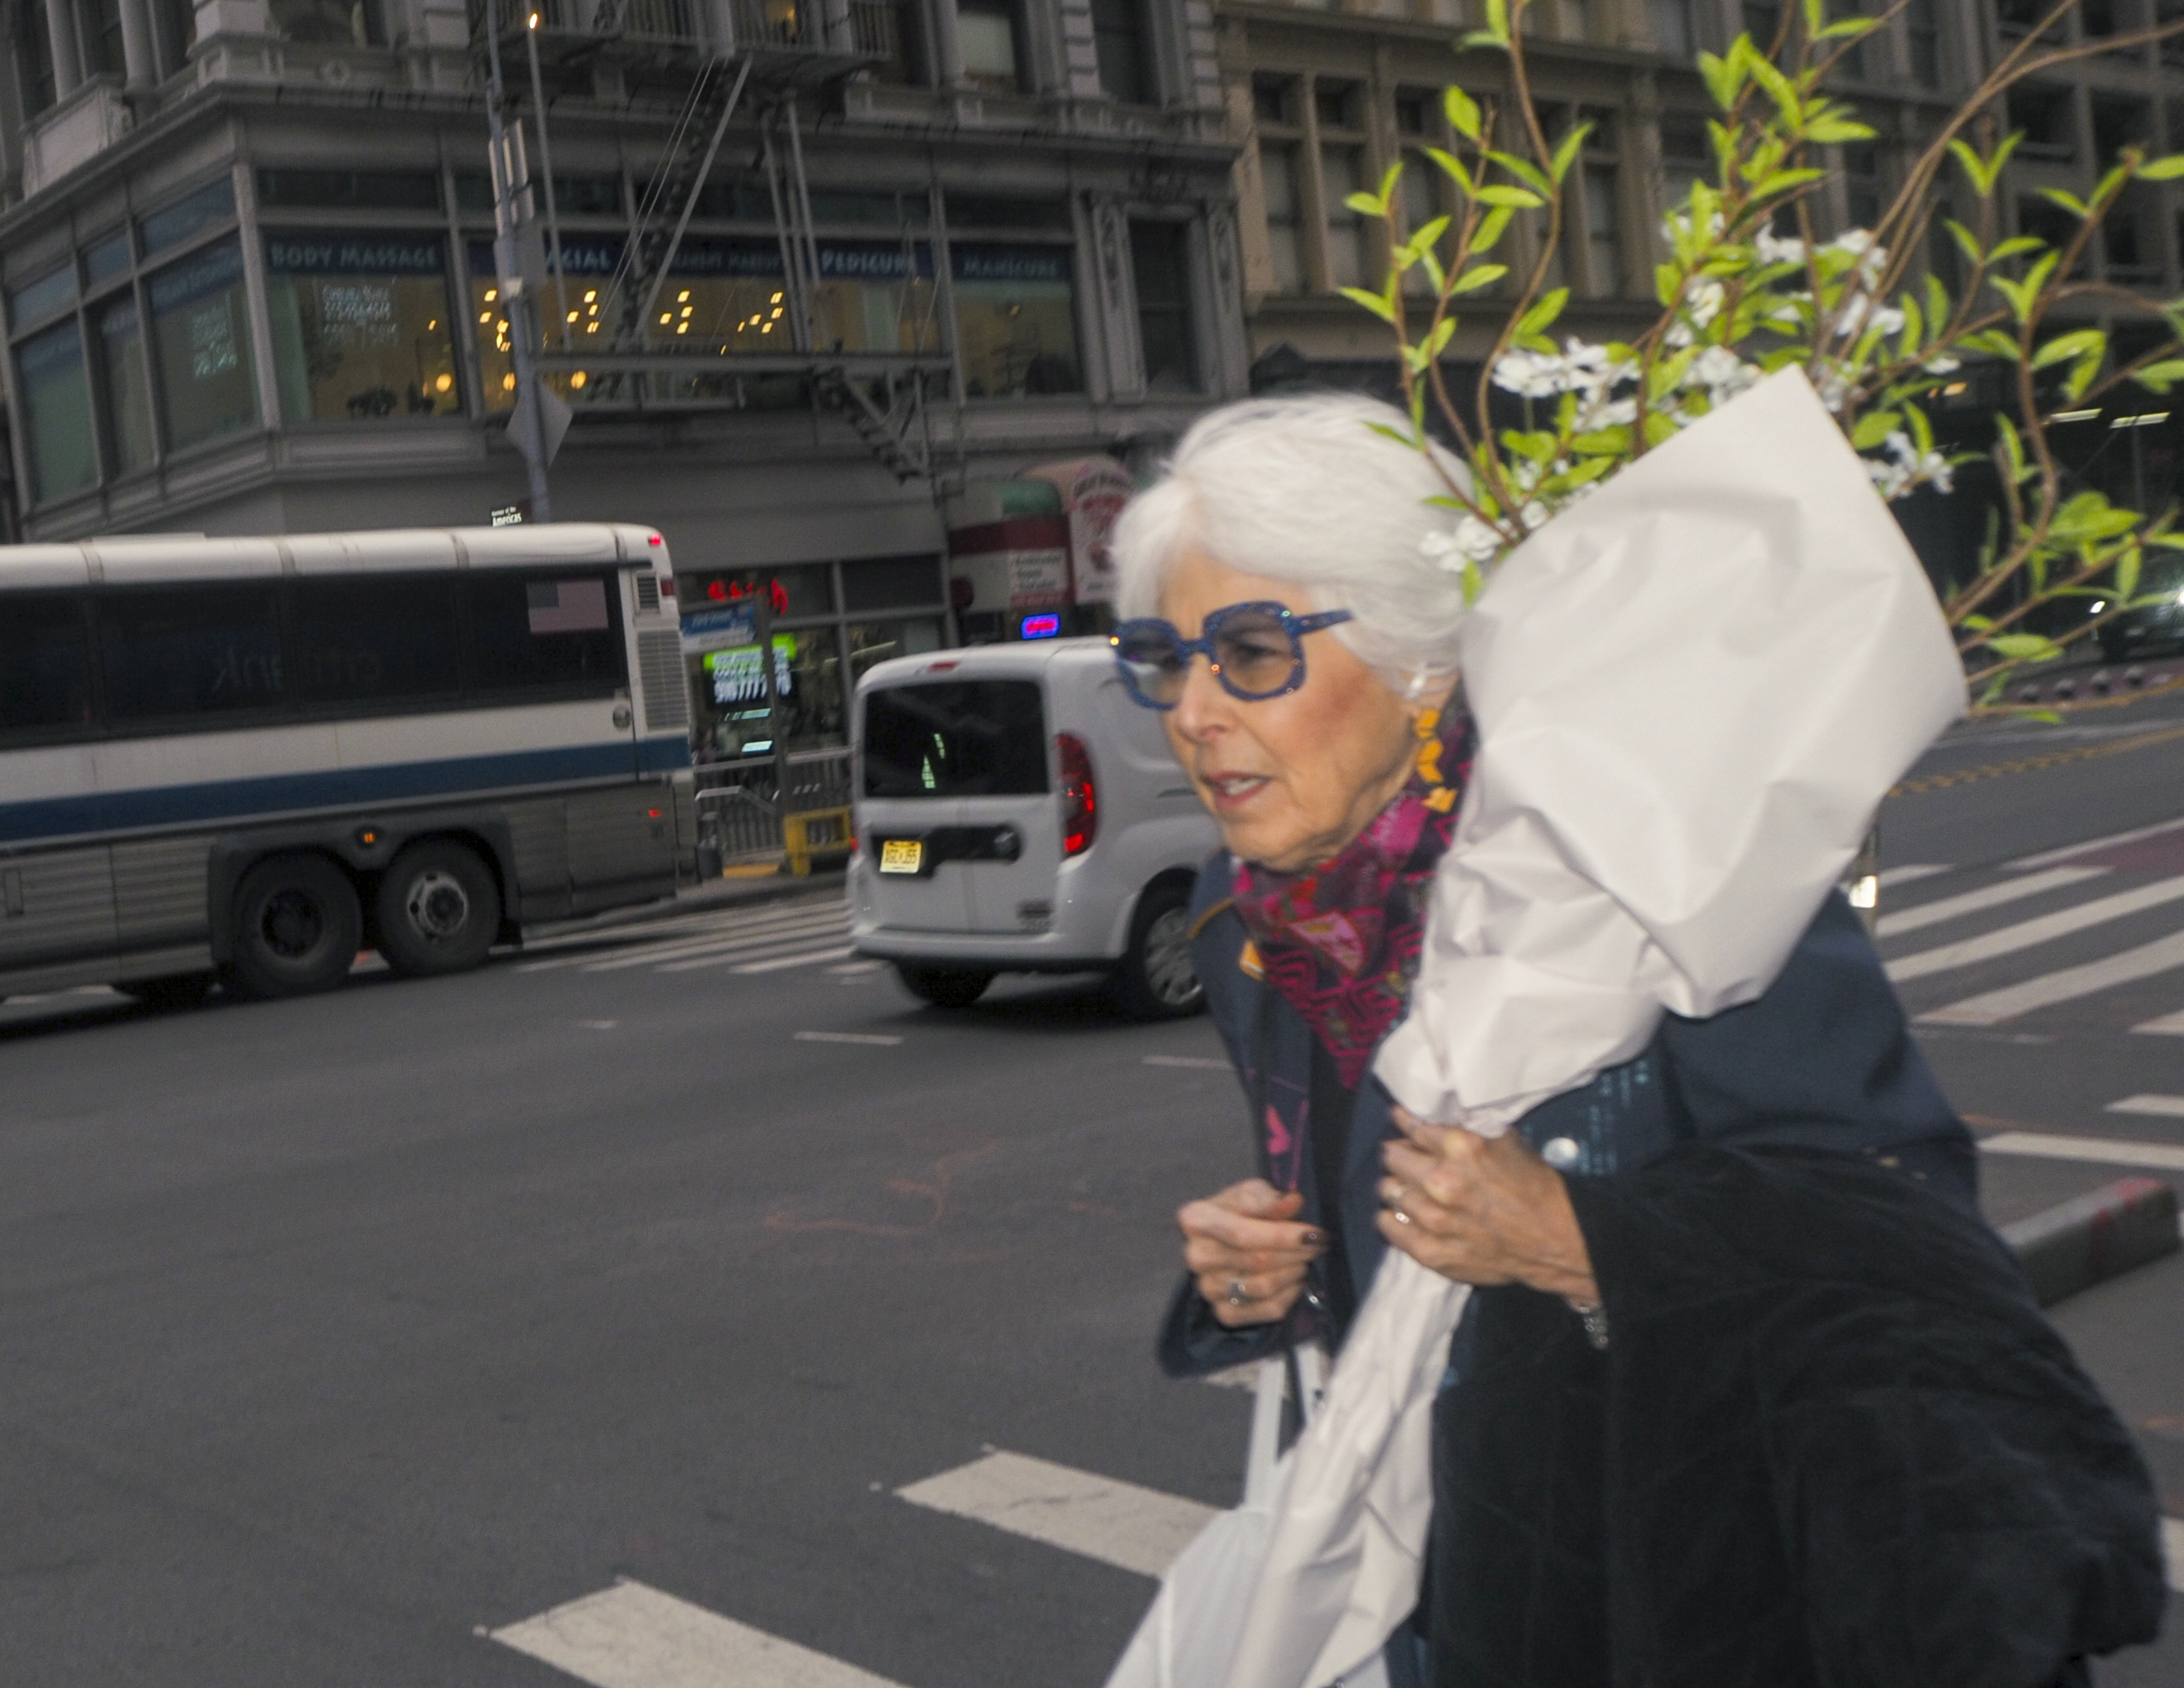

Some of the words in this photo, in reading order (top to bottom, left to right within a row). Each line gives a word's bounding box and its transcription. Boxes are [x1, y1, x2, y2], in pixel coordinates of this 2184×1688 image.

[270, 241, 332, 268] BODY
[339, 243, 438, 268] MASSAGE
[492, 513, 522, 527] Americas
